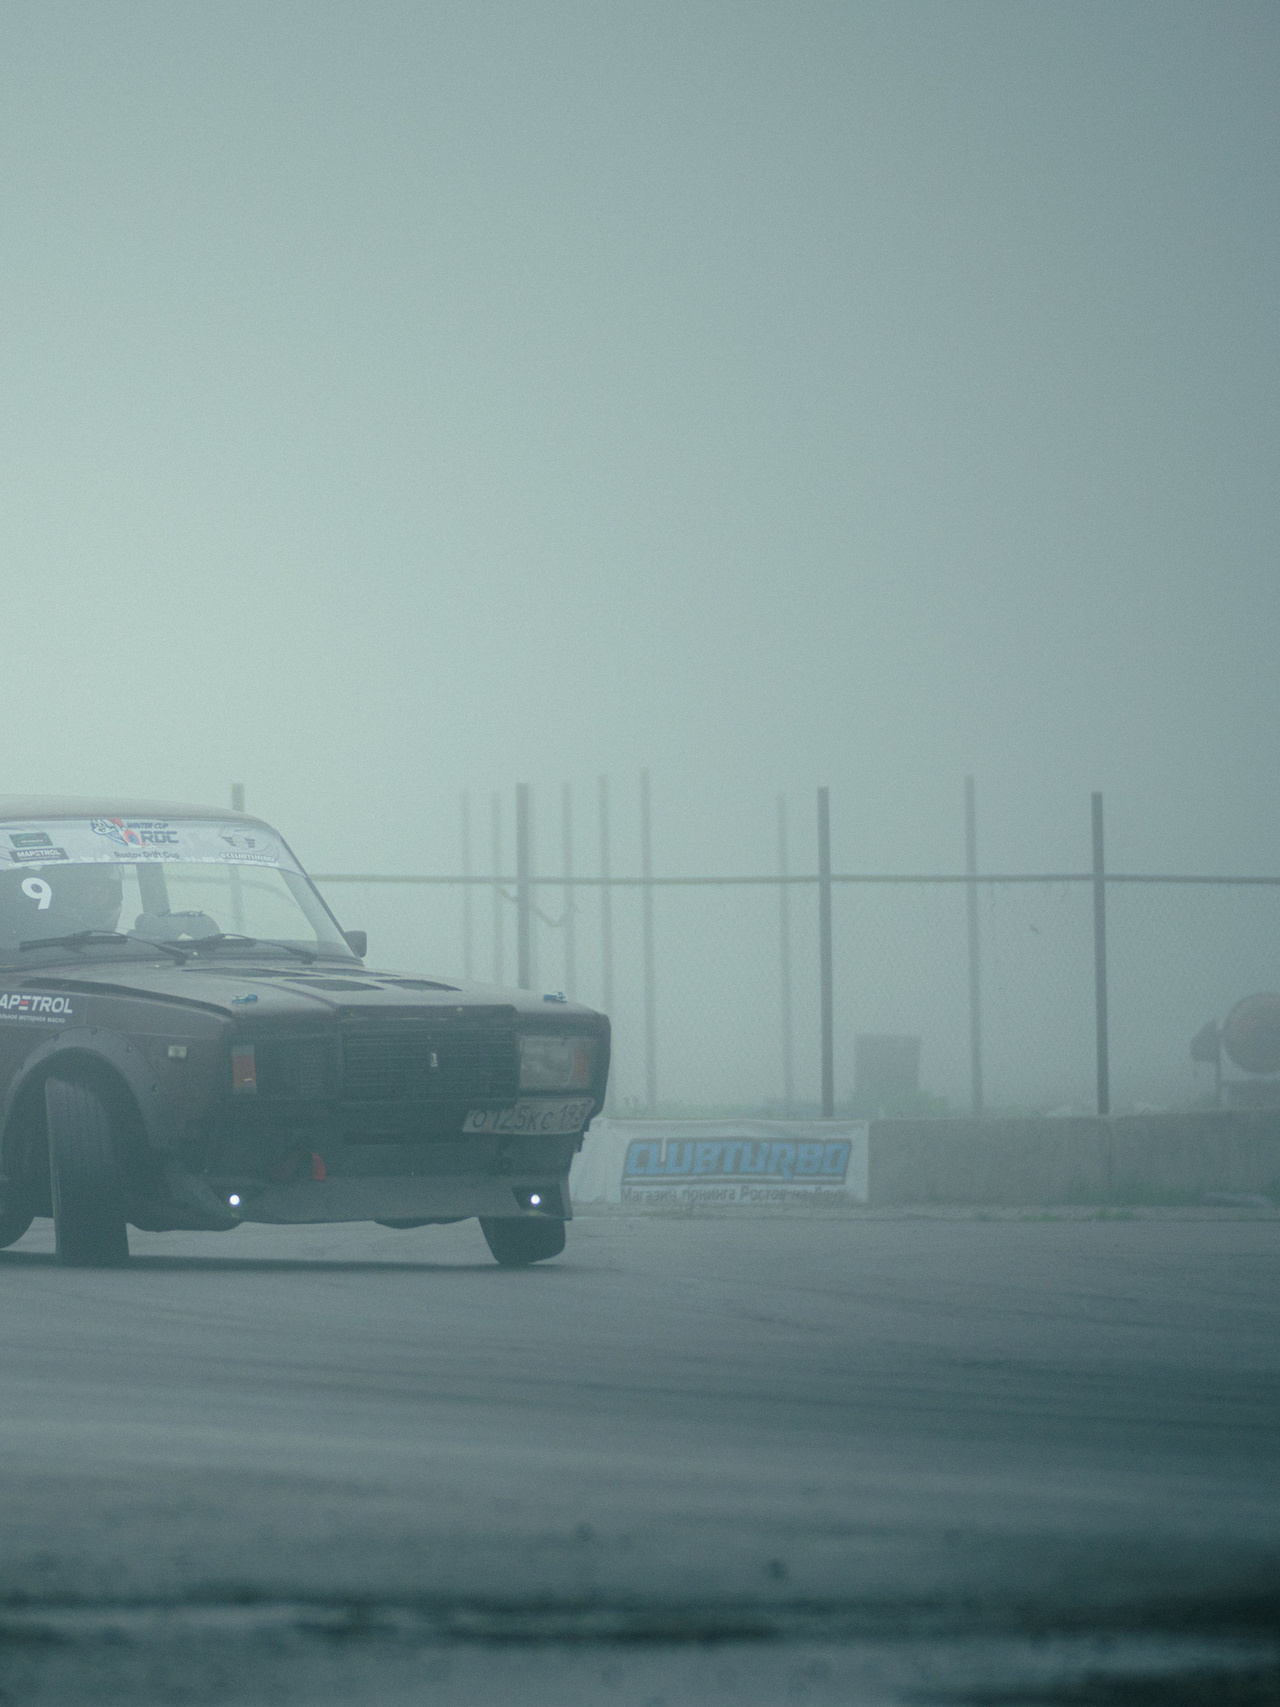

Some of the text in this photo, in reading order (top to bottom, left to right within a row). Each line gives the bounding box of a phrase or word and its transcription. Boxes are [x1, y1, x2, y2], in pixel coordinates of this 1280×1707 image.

[140, 830, 180, 844] RDC
[21, 877, 53, 910] 9
[624, 1140, 853, 1181] CLUBTURBO
